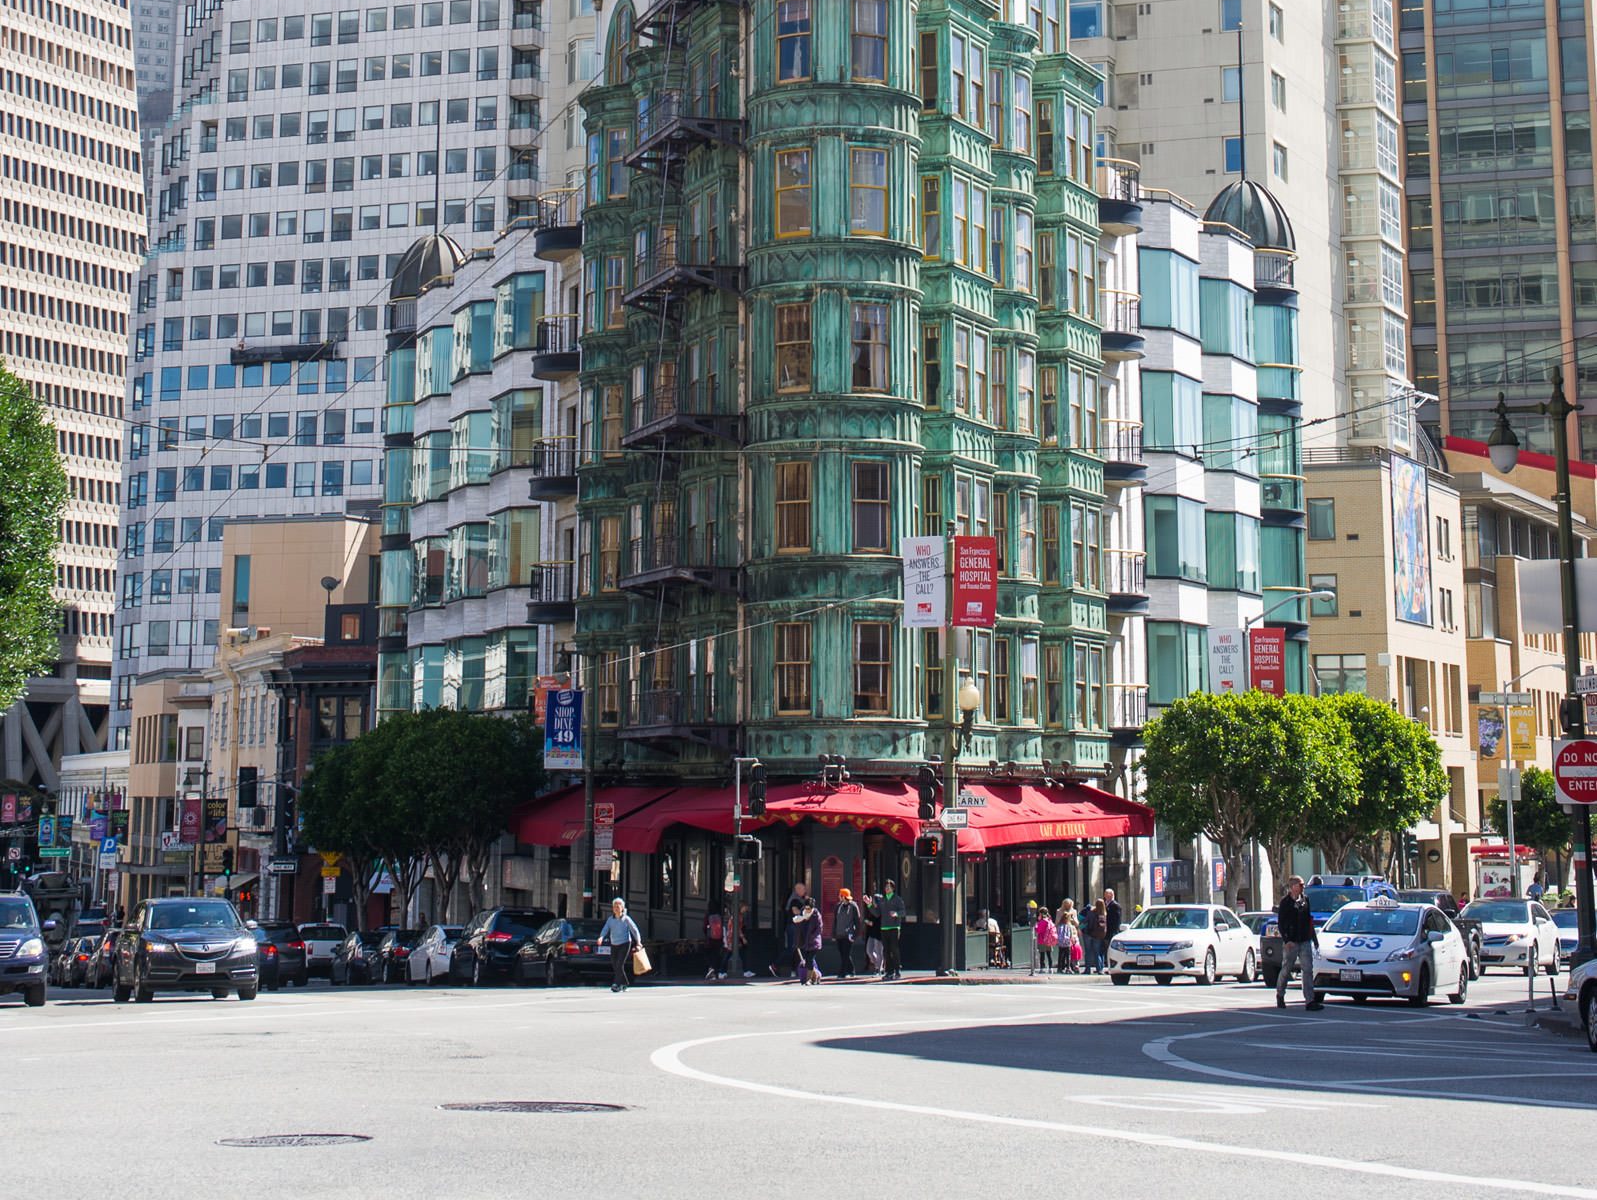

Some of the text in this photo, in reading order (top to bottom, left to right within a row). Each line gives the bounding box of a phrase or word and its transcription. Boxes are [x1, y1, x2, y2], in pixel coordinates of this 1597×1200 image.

[916, 545, 931, 556] WHO
[960, 547, 991, 555] San Francisco
[909, 557, 940, 569] ANSWERS
[960, 557, 992, 569] GENERAL
[918, 570, 931, 582] THE
[960, 570, 992, 582] HOSPITAL
[915, 583, 934, 595] CALL?
[1218, 634, 1232, 644] WHO
[1213, 644, 1239, 654] ANSWERS
[1254, 644, 1280, 654] GENERAL
[1221, 655, 1231, 664] THE
[1254, 655, 1280, 664] HOSPITAL
[1219, 665, 1235, 675] CALL?
[553, 718, 574, 730] DINE
[553, 730, 574, 742] 49
[1563, 752, 1578, 763] DO
[1568, 780, 1597, 791] ENTE
[207, 801, 226, 809] color
[957, 797, 986, 805] ARNY
[213, 809, 226, 817] life
[1335, 936, 1383, 950] 963
